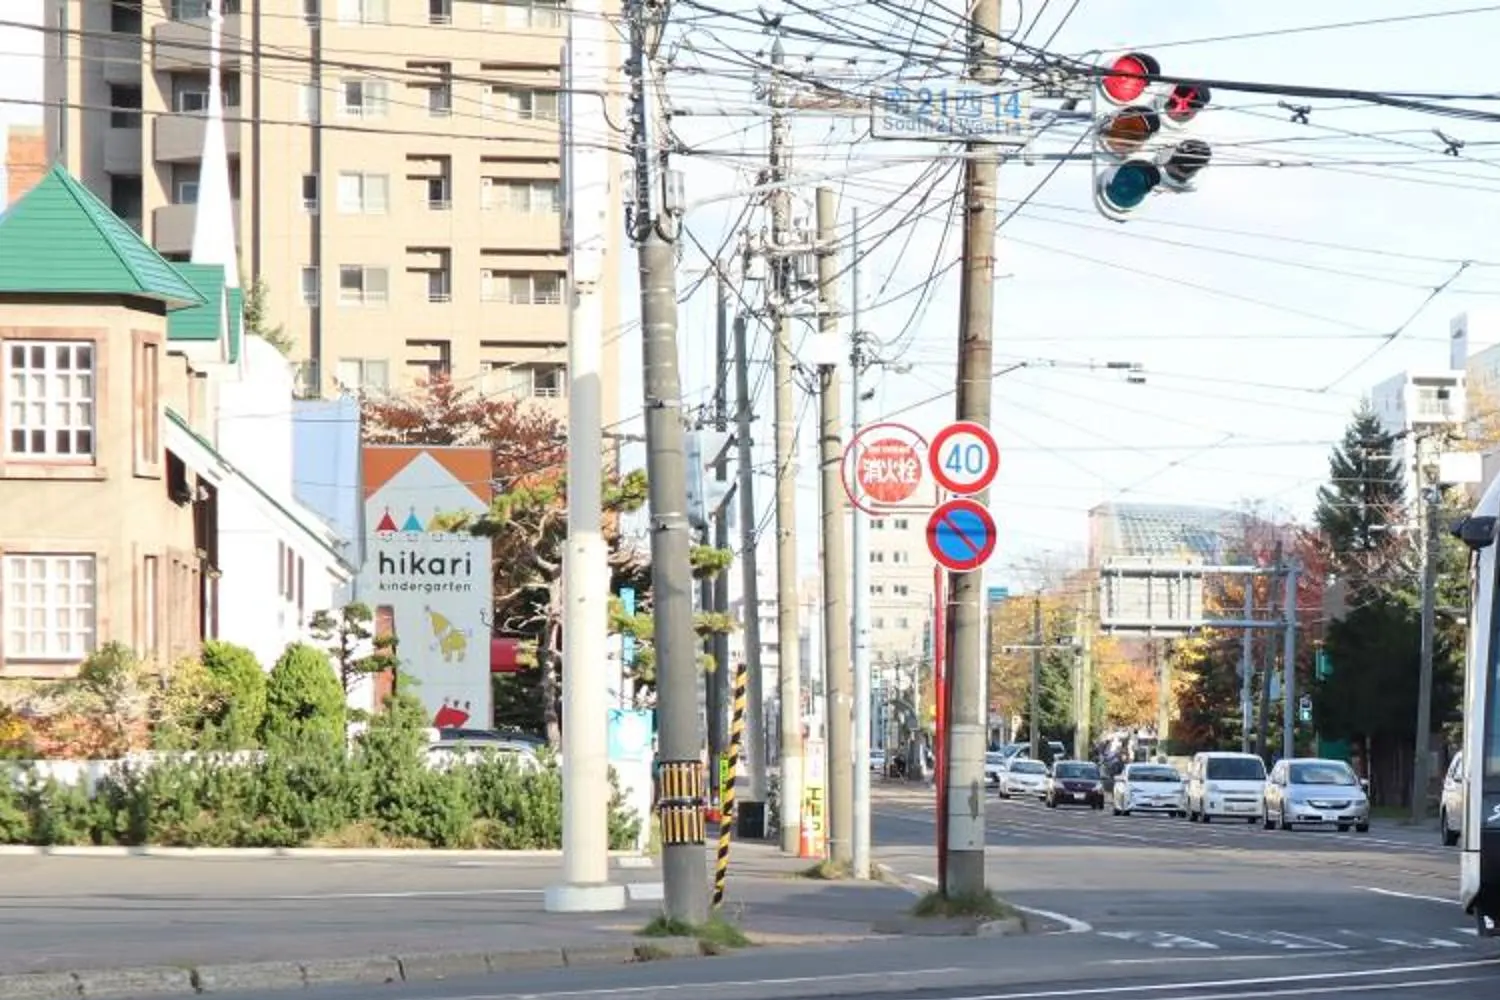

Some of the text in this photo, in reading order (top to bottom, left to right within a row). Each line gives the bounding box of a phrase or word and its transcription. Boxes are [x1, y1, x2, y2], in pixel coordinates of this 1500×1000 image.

[862, 457, 917, 485] 消火栓
[945, 443, 984, 474] 40
[379, 550, 472, 576] hikari
[379, 581, 472, 594] kindergarten
